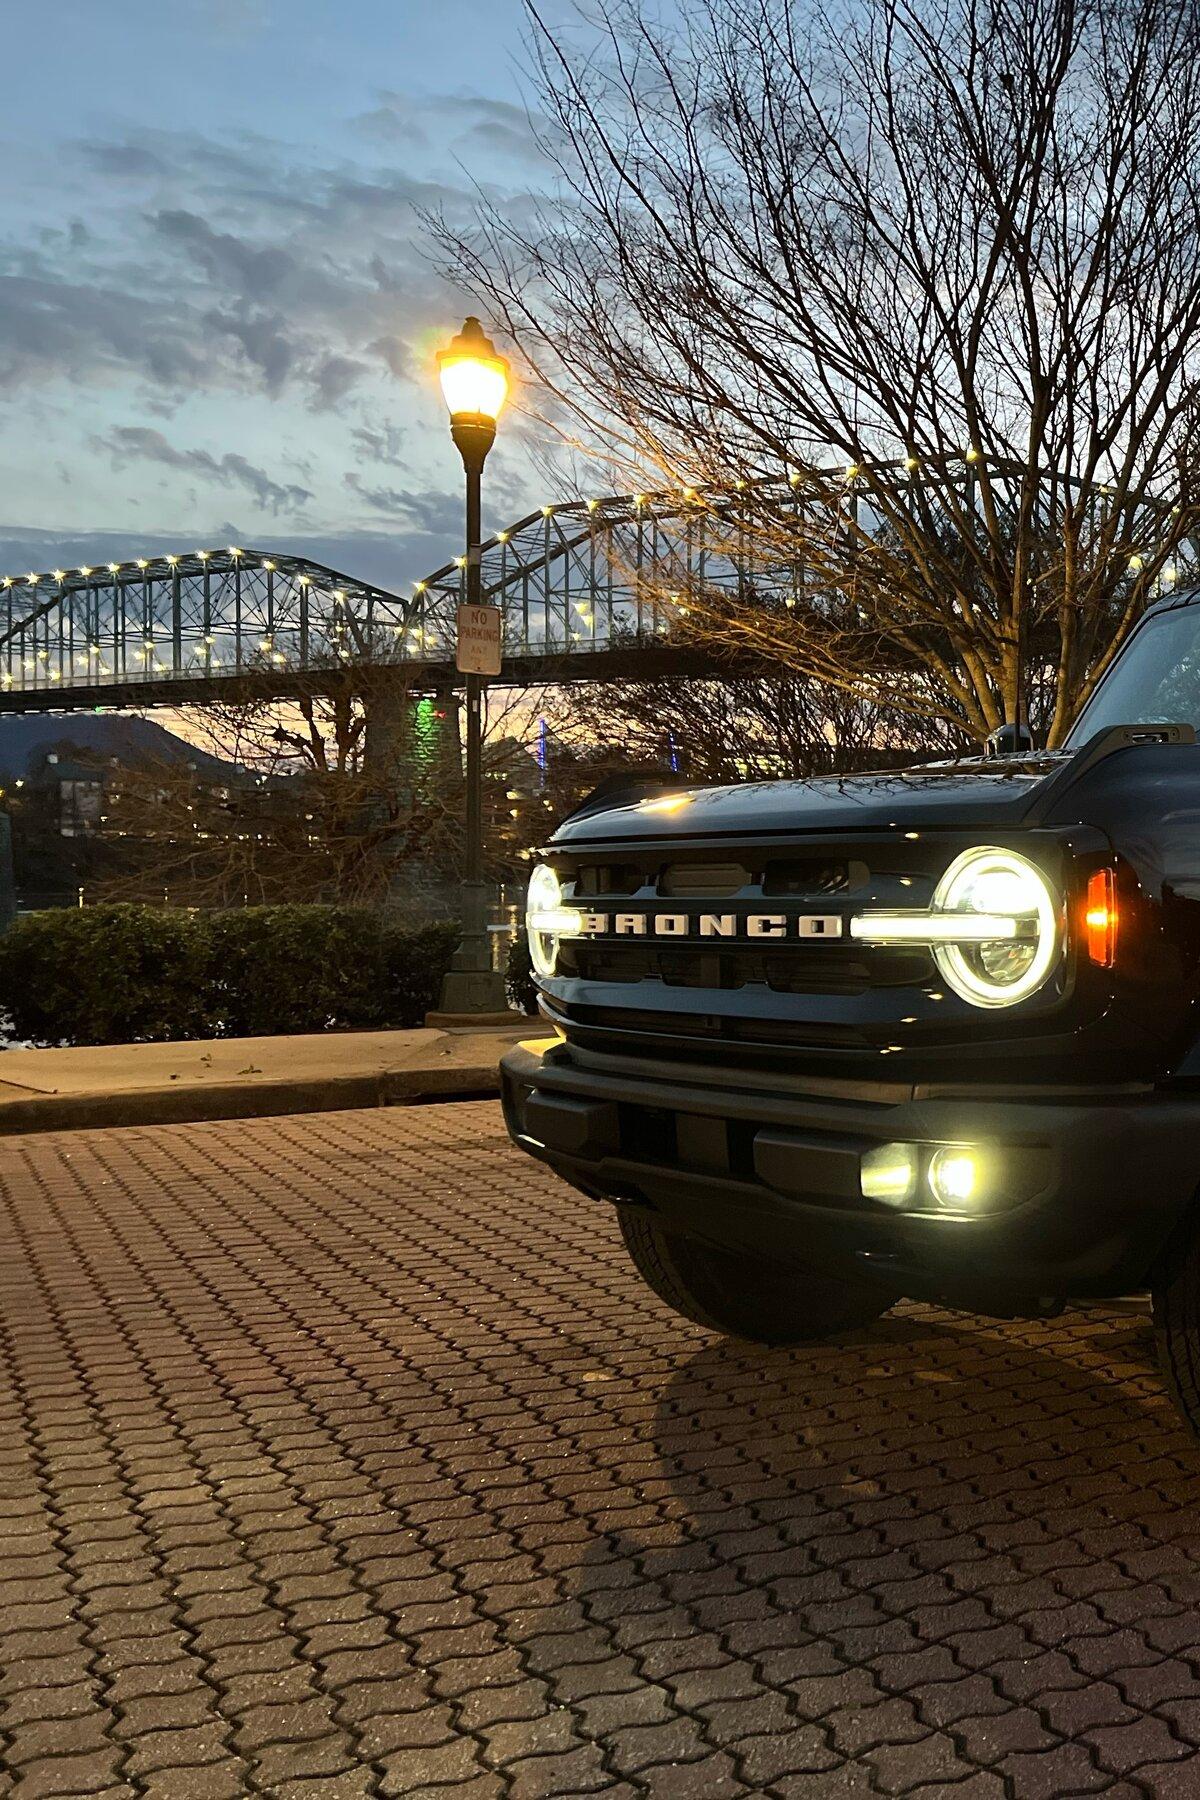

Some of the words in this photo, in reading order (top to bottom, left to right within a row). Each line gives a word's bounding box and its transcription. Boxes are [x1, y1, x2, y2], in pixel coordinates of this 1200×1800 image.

[471, 610, 487, 625] NO
[460, 626, 499, 642] PARKING
[581, 912, 843, 938] BRONCO
